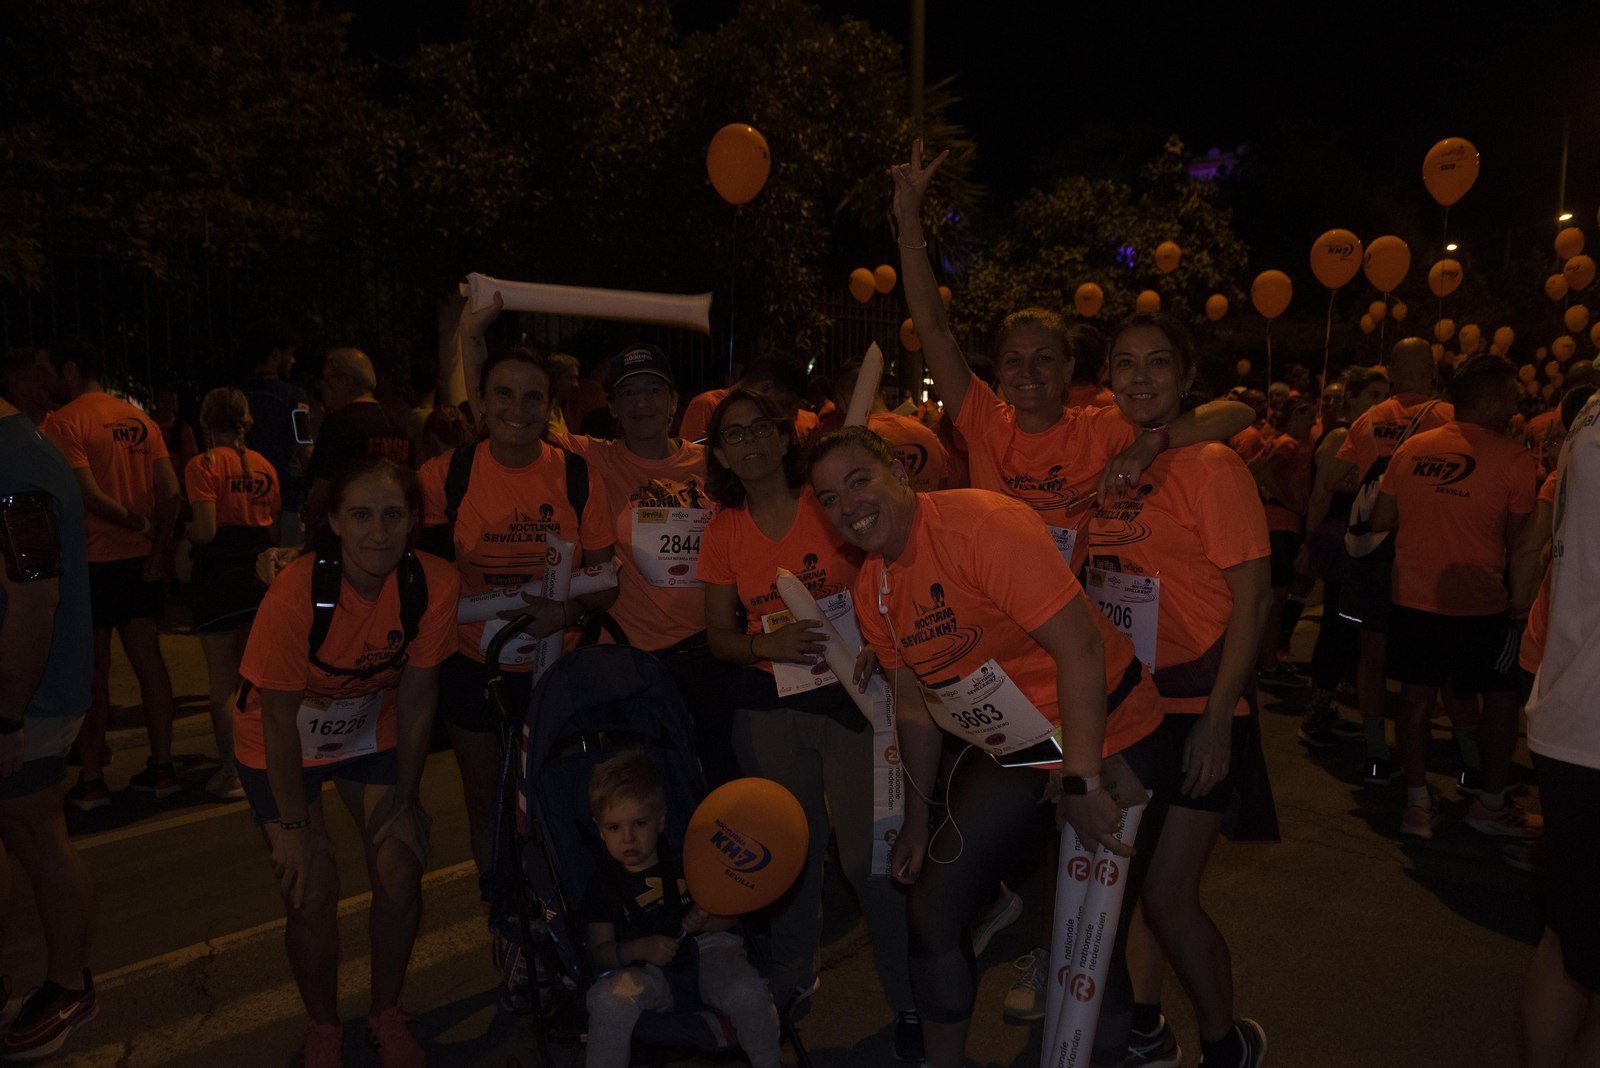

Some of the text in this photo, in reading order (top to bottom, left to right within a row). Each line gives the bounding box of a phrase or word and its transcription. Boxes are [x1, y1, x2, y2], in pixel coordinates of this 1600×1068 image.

[1410, 455, 1447, 463] NOCTURNA
[1434, 486, 1471, 498] SEVILLA
[1112, 501, 1145, 511] NOCTURNA
[483, 532, 534, 543] SEVILLA
[508, 522, 561, 533] NOCTURNA
[659, 534, 700, 554] 2844
[469, 592, 500, 603] nationale
[914, 606, 955, 630] NOCTURNA
[1098, 600, 1132, 629] 7206
[901, 629, 936, 648] SEVILLA
[884, 684, 892, 727] nederlanden
[951, 703, 1004, 729] 3663
[309, 714, 367, 736] 16226
[714, 819, 747, 848] NOCTURNA
[724, 869, 755, 890] SEVILLA
[1064, 918, 1075, 961] nationale
[1079, 923, 1094, 968] nationale
[1089, 911, 1107, 971] nederlanden
